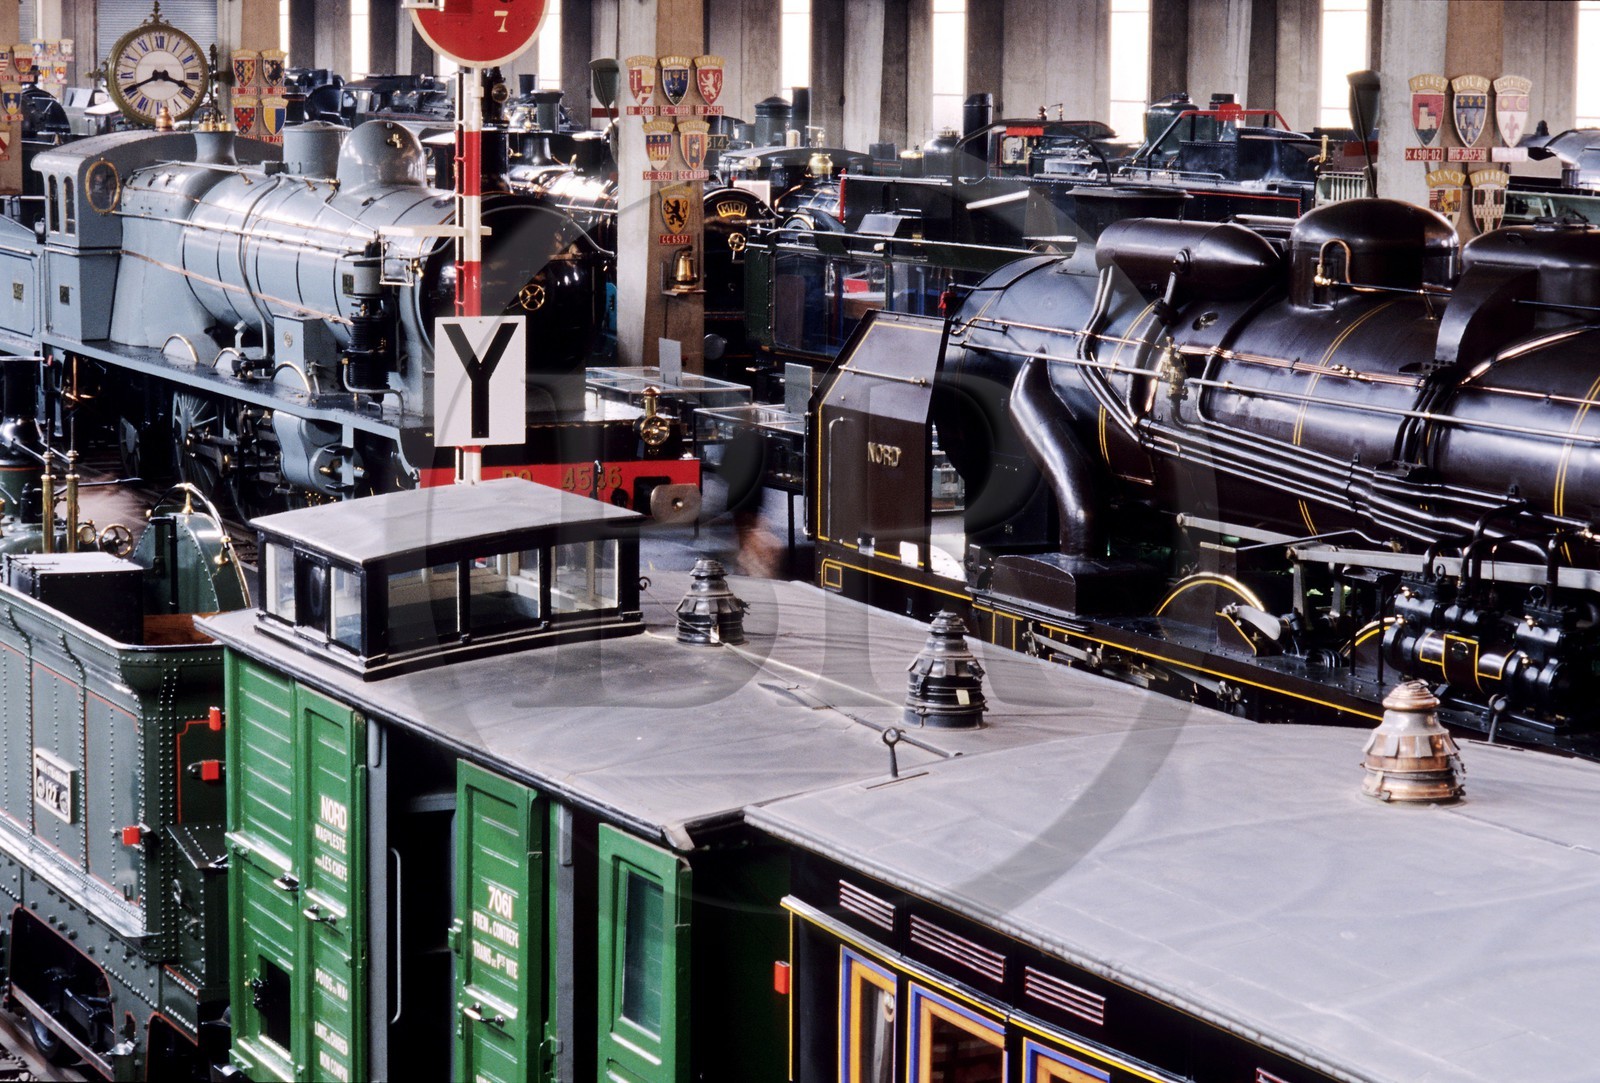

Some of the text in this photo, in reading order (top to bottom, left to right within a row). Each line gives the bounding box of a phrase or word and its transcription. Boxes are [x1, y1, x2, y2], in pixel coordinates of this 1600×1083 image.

[494, 10, 508, 32] 7
[1455, 78, 1489, 90] TOURS
[1413, 149, 1440, 160] 4901-02
[1429, 170, 1463, 184] NANCY
[1474, 171, 1506, 184] DINARD
[720, 202, 745, 215] MIDI
[673, 235, 689, 243] 6537
[442, 323, 519, 438] Y
[868, 441, 901, 467] NORD
[321, 795, 347, 832] NORD
[488, 885, 513, 921] 7061
